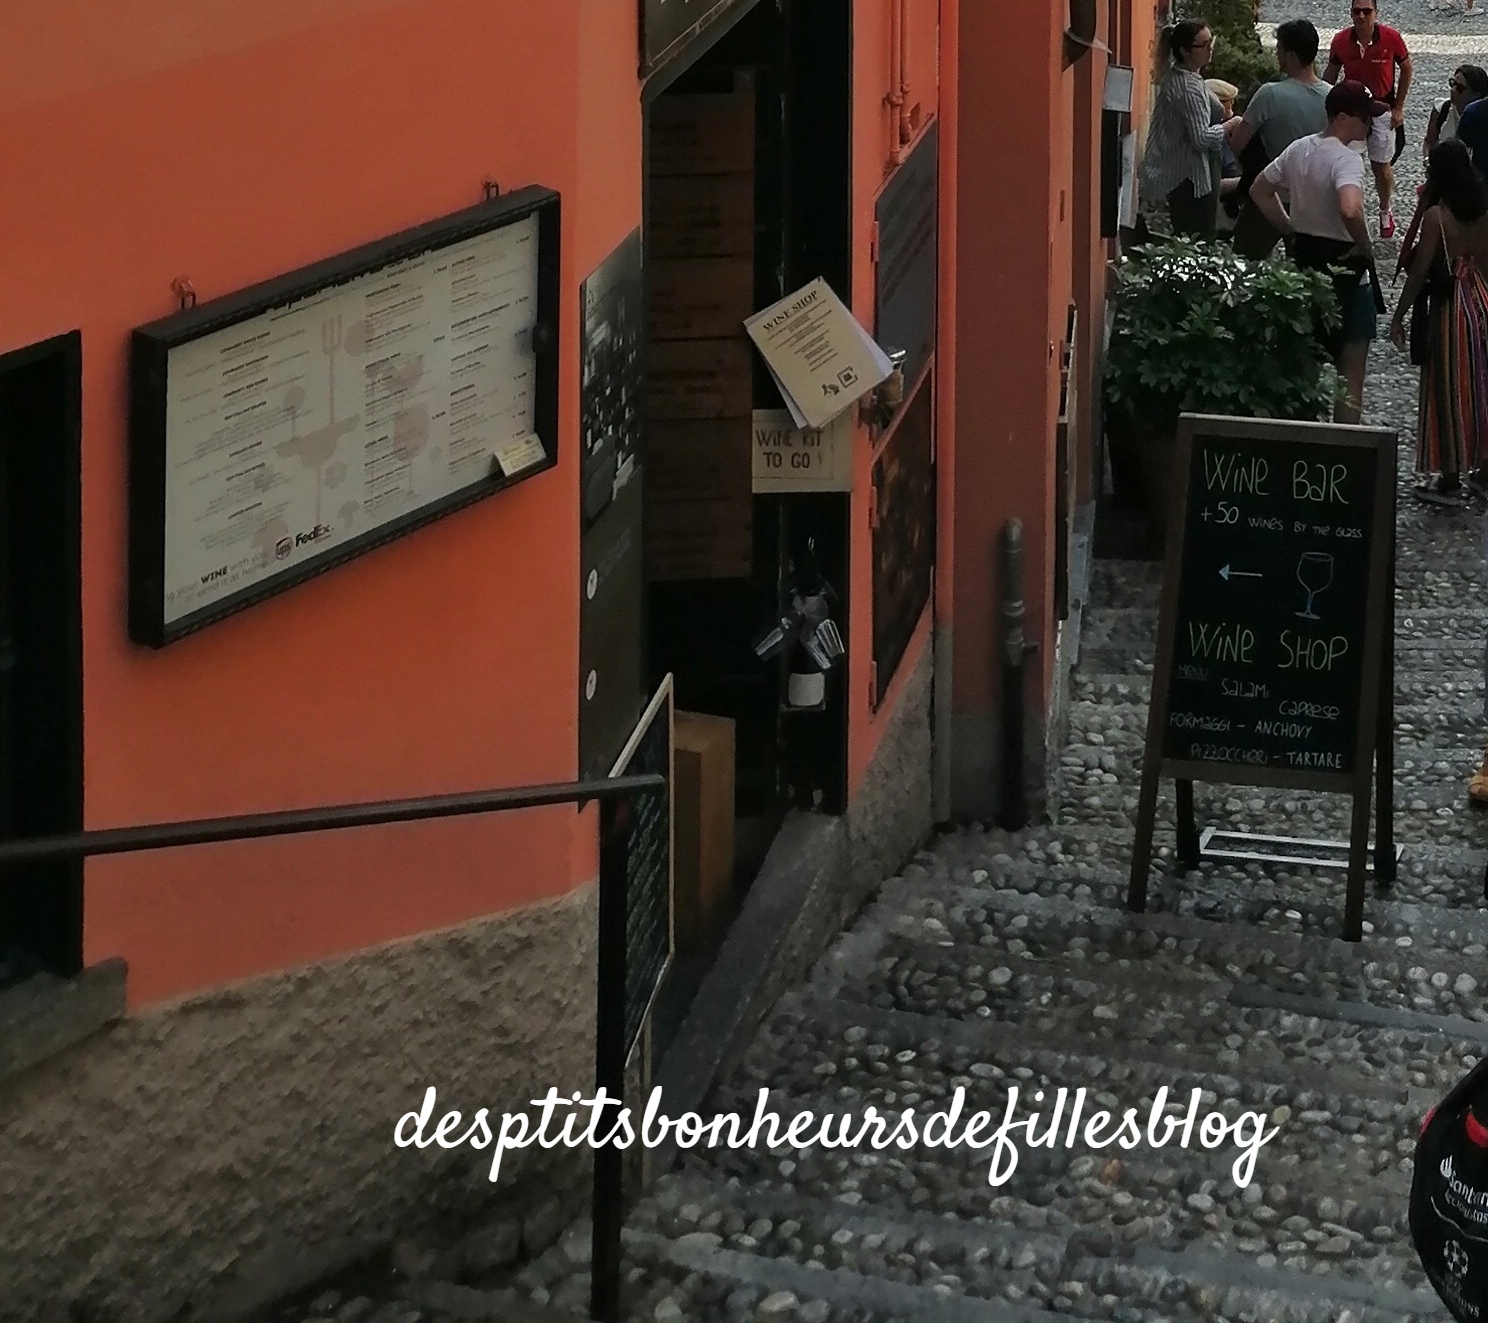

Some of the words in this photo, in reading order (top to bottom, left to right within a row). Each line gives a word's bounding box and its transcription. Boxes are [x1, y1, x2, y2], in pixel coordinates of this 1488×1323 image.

[762, 308, 791, 331] WINE
[791, 290, 818, 312] SHOP
[762, 451, 783, 469] TO
[295, 523, 332, 547] FedEx
[200, 565, 229, 585] WINE
[1277, 629, 1349, 672] SHOP
[1285, 751, 1342, 769] TARTARE
